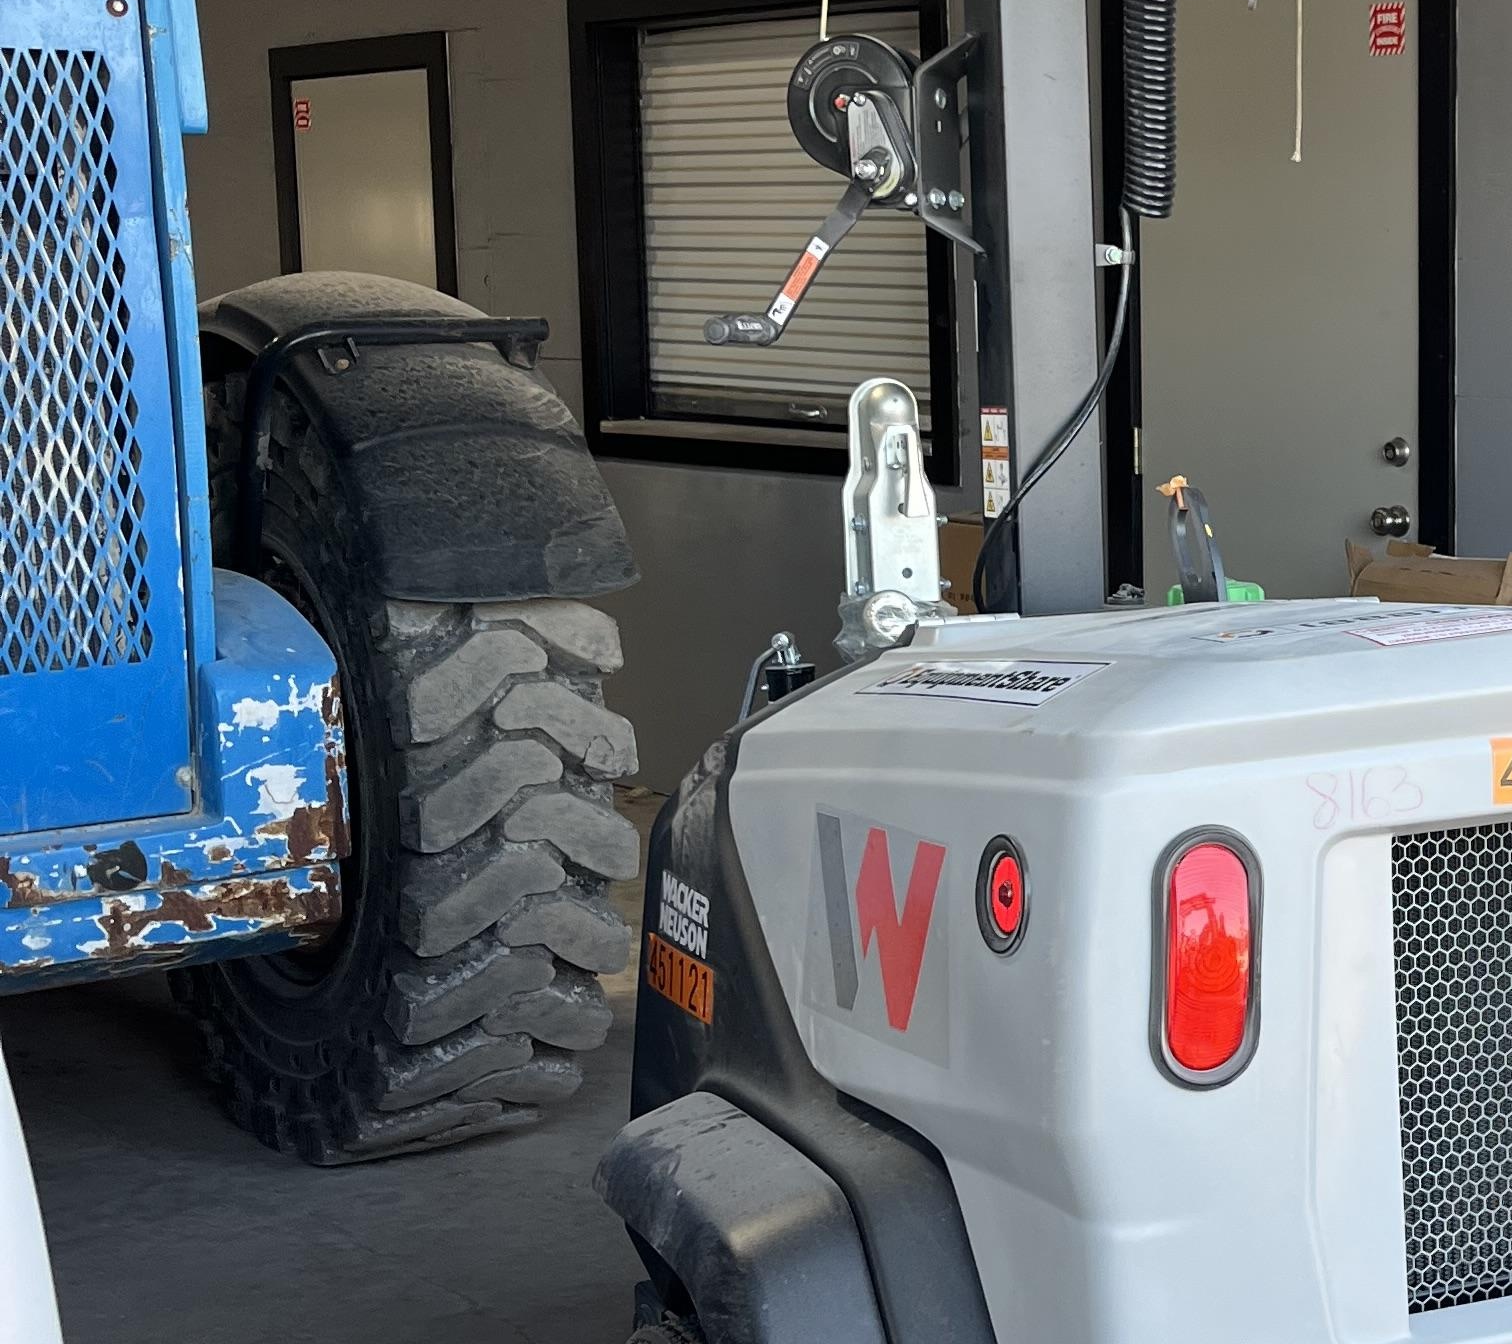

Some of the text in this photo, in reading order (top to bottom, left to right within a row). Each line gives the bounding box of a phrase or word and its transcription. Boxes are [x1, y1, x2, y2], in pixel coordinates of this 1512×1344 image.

[1376, 12, 1398, 25] FIRE
[1305, 766, 1424, 830] 8163
[661, 869, 710, 928] WACKER
[659, 901, 709, 960] NEUSON
[649, 937, 708, 1018] 451121
